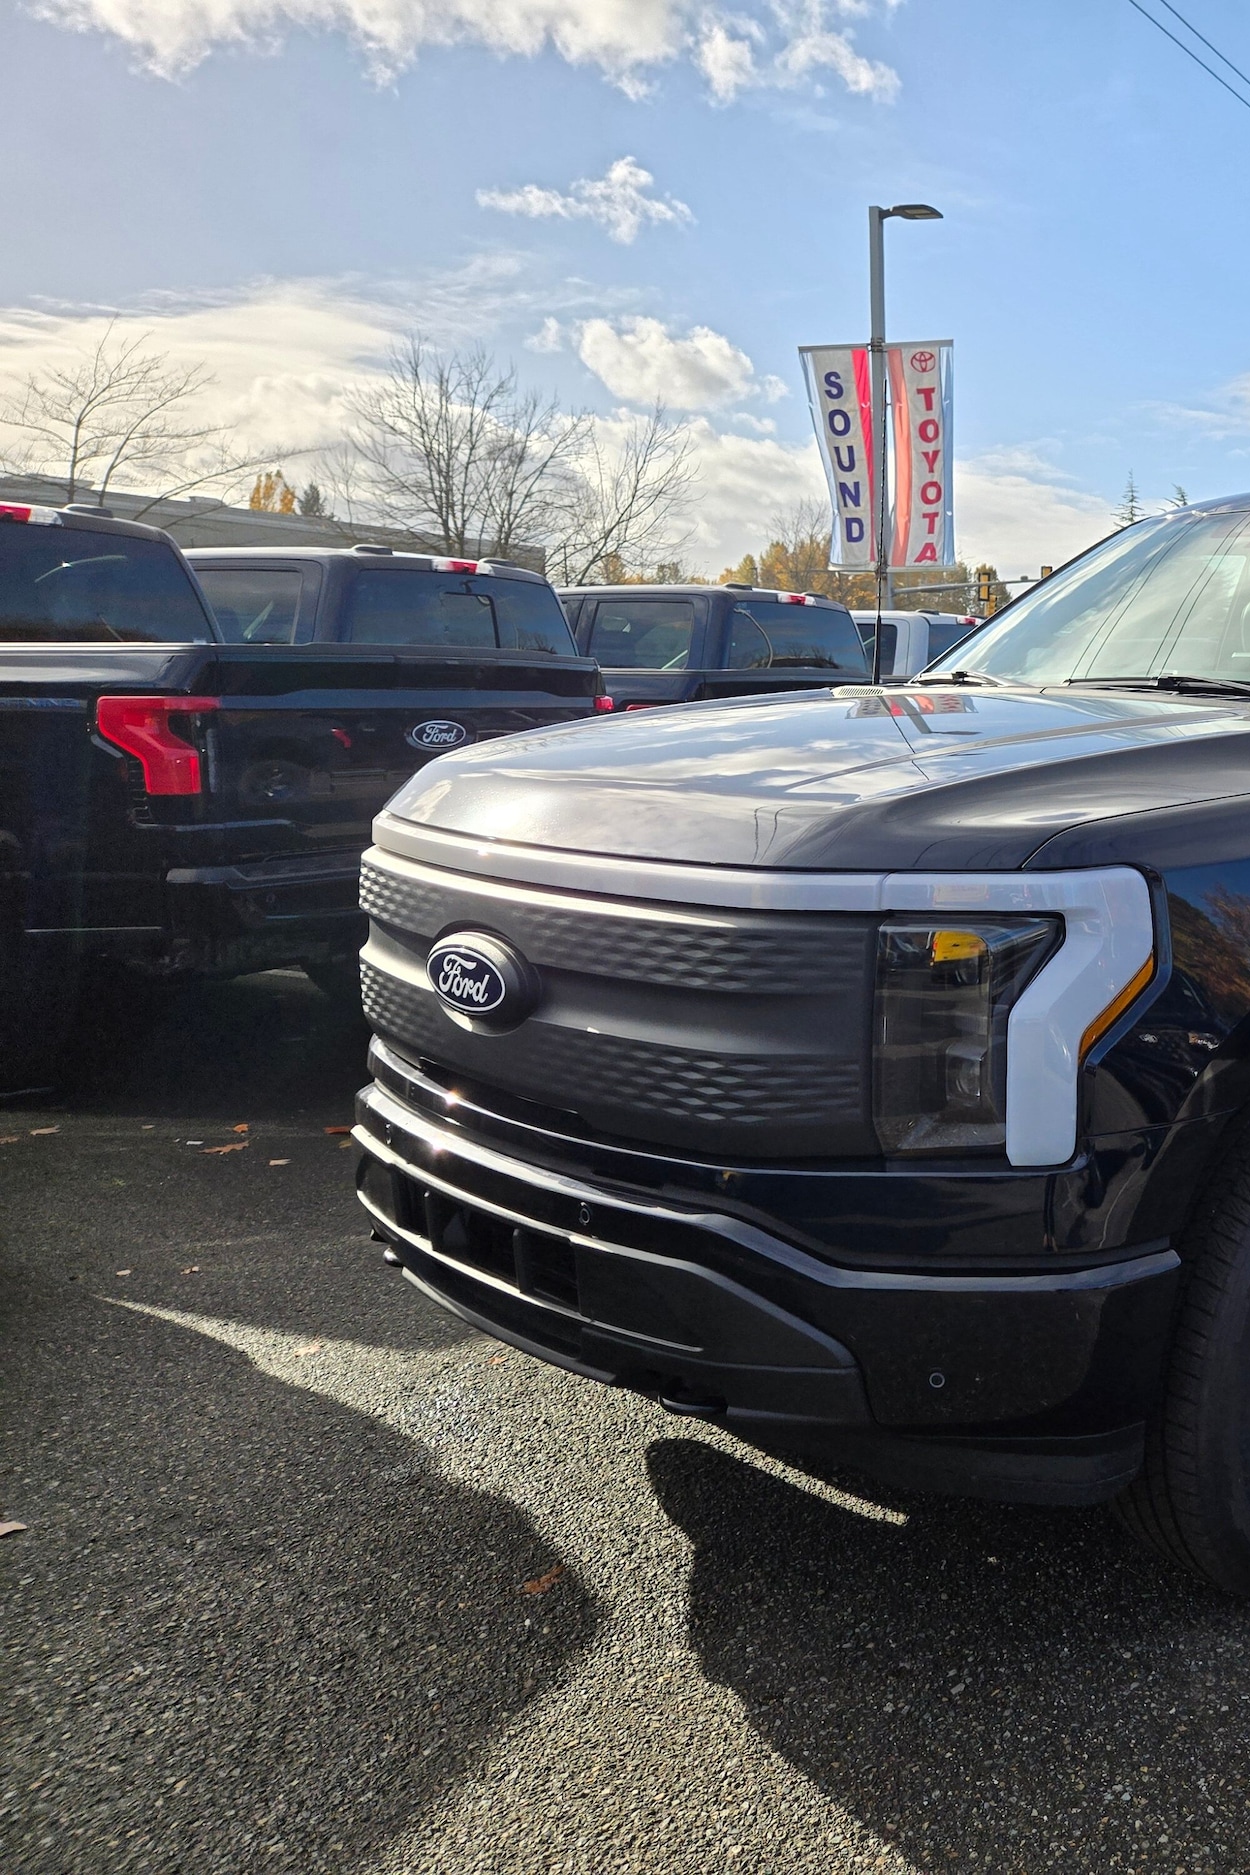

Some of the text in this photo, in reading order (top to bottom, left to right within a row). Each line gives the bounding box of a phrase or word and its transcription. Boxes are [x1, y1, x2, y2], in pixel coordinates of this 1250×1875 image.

[824, 371, 865, 544] SOUND
[913, 387, 942, 563] TOYOTA
[424, 723, 458, 744] Ford
[439, 954, 490, 1005] Ford
